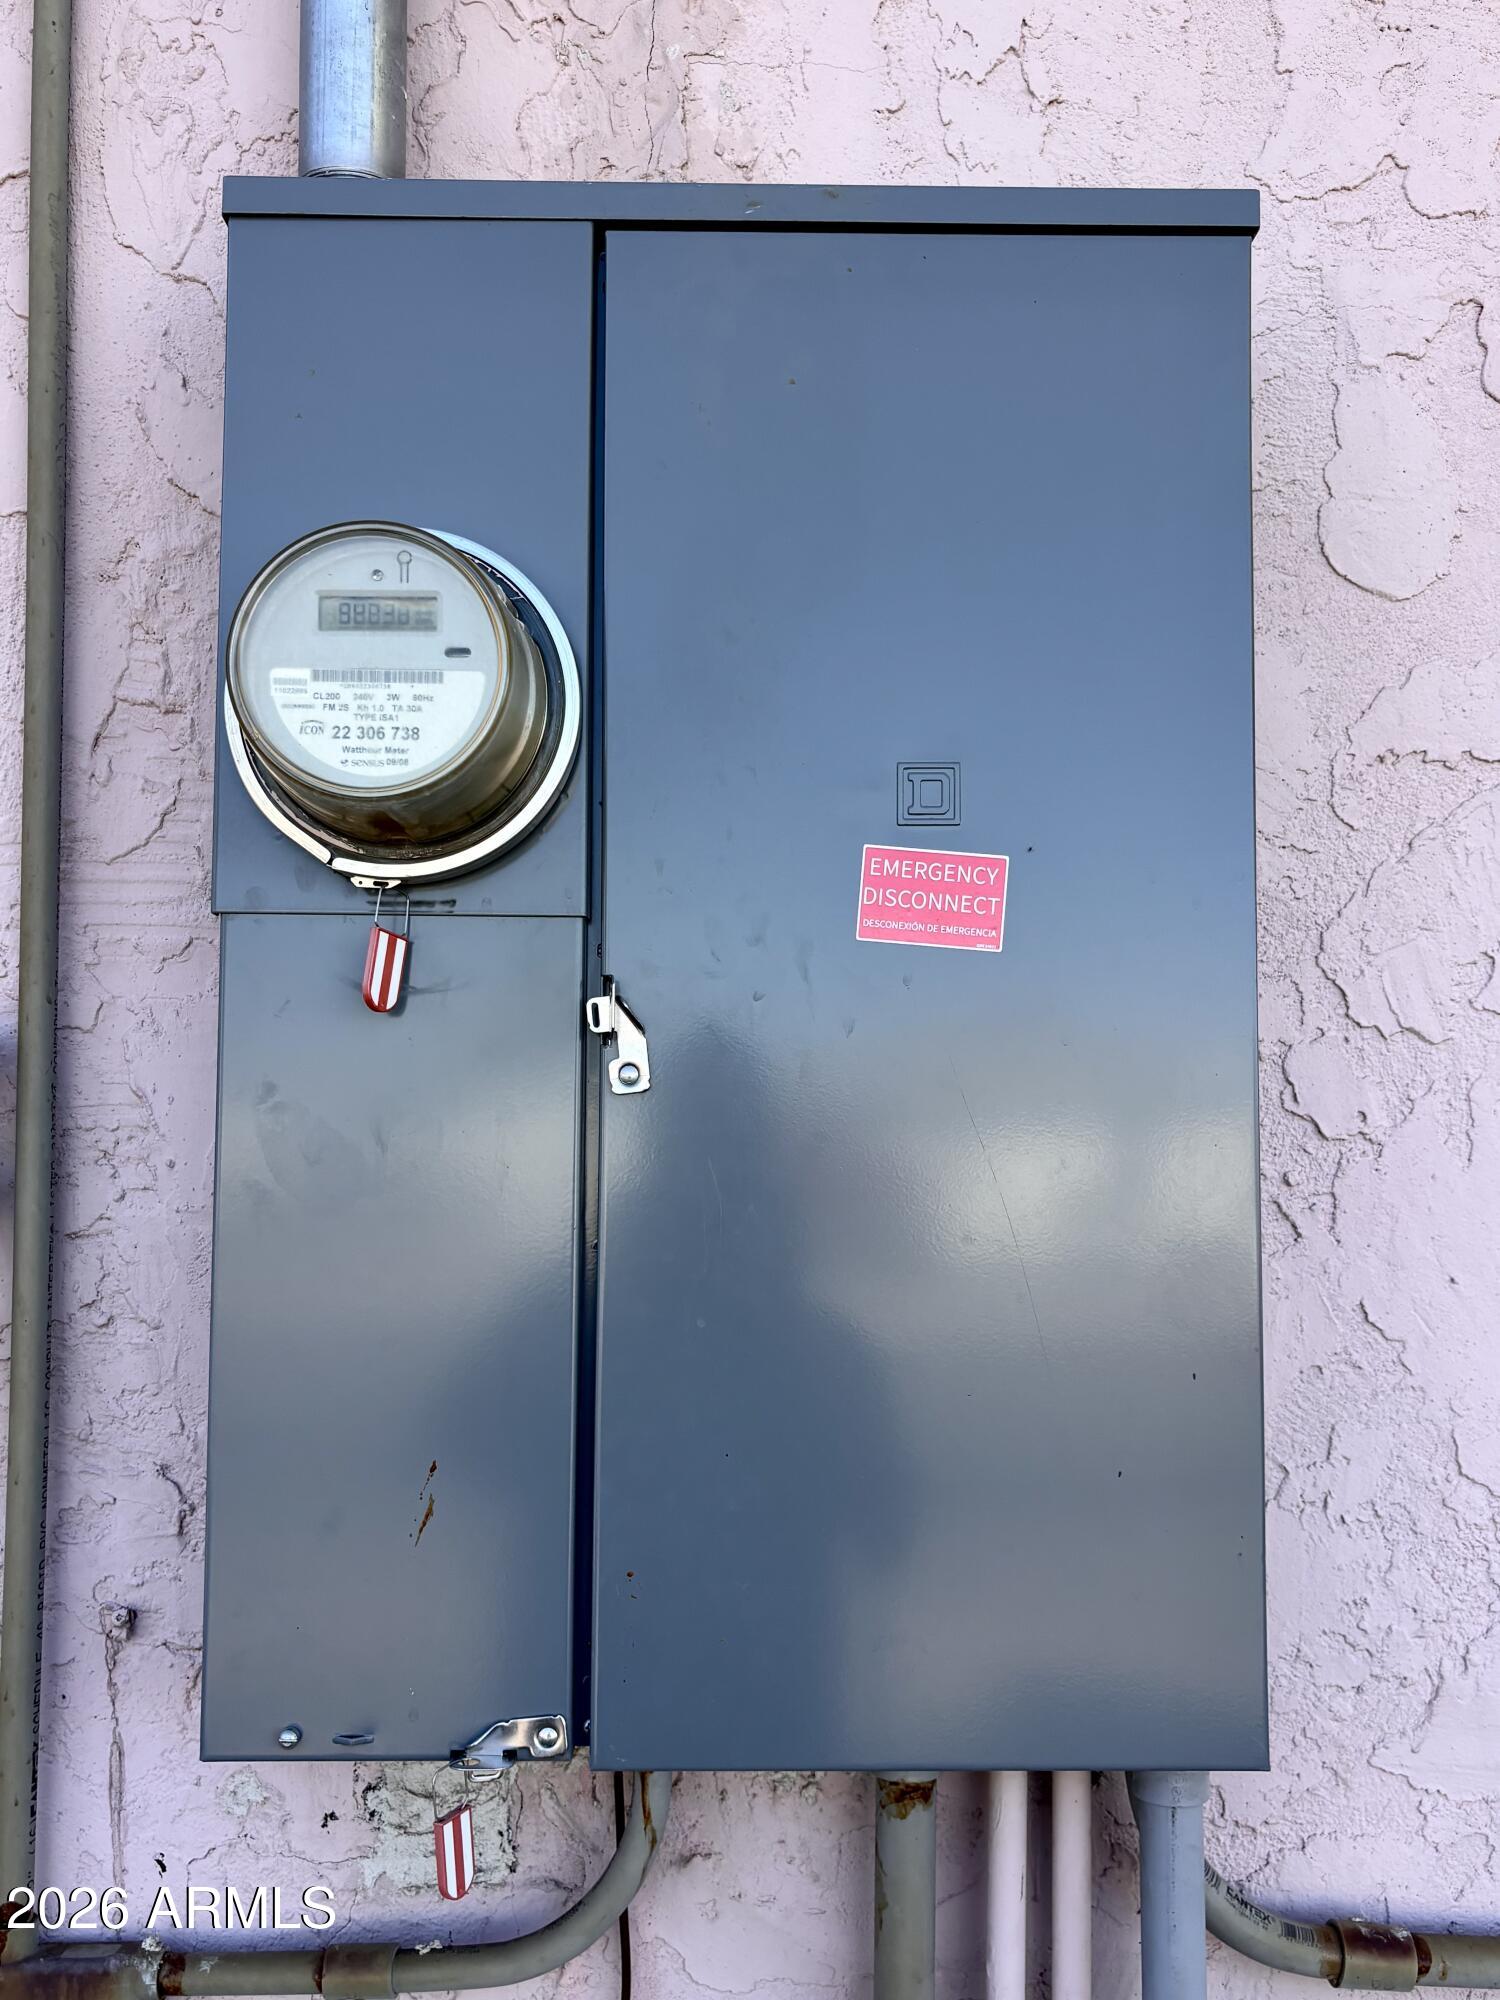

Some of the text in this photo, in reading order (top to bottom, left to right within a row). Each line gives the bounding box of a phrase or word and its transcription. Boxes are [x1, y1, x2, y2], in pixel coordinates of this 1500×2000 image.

[313, 692, 341, 700] CL200
[353, 713, 377, 721] TYPE
[331, 726, 420, 740] 22 306 738
[342, 745, 410, 754] Watthour Meter
[870, 857, 1000, 886] EMERGENCY
[863, 886, 1001, 916] DISCONNECT
[863, 918, 997, 938] DESCONEXIÓN DE EMERGENCIA
